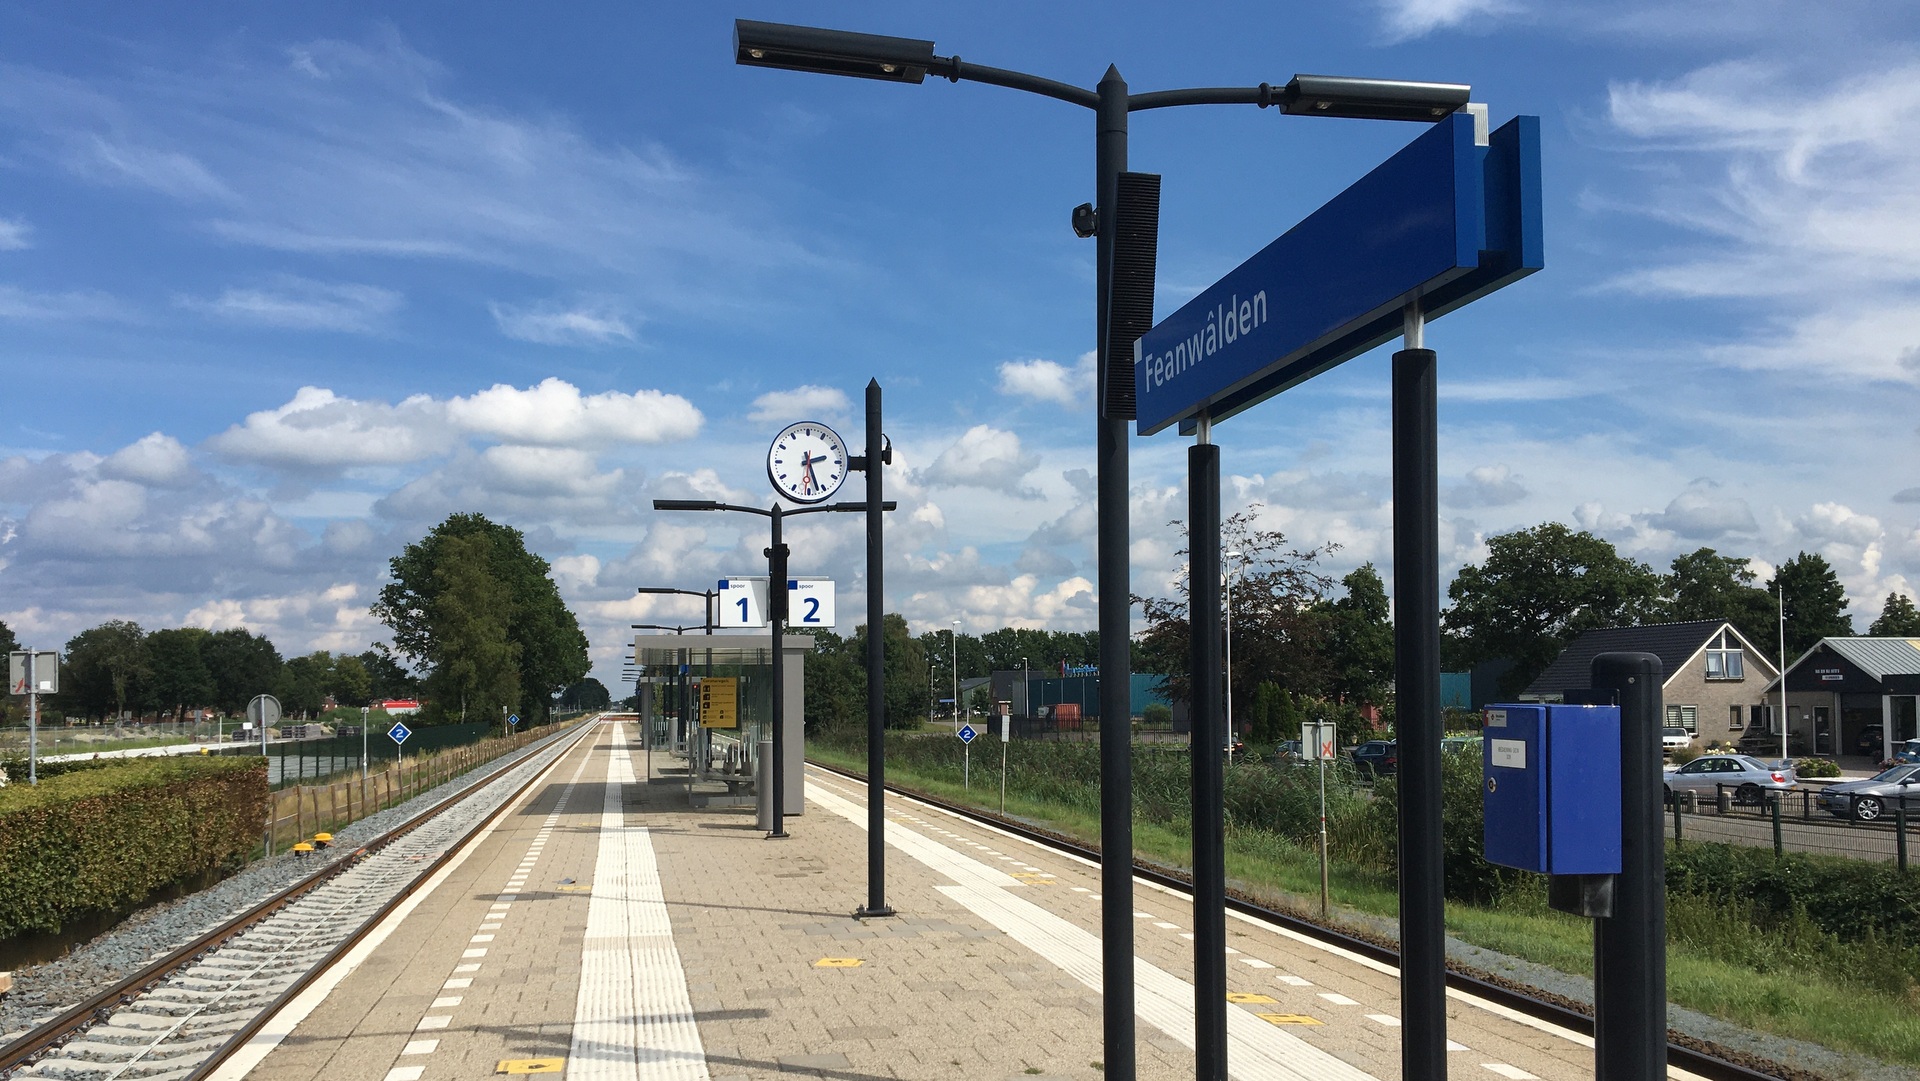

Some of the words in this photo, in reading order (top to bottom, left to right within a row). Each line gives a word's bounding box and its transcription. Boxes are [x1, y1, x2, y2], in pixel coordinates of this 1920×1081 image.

[1145, 289, 1268, 393] Feanwâlden
[736, 597, 748, 622] 1
[803, 597, 820, 622] 2
[395, 728, 404, 738] 2
[963, 730, 971, 738] 2
